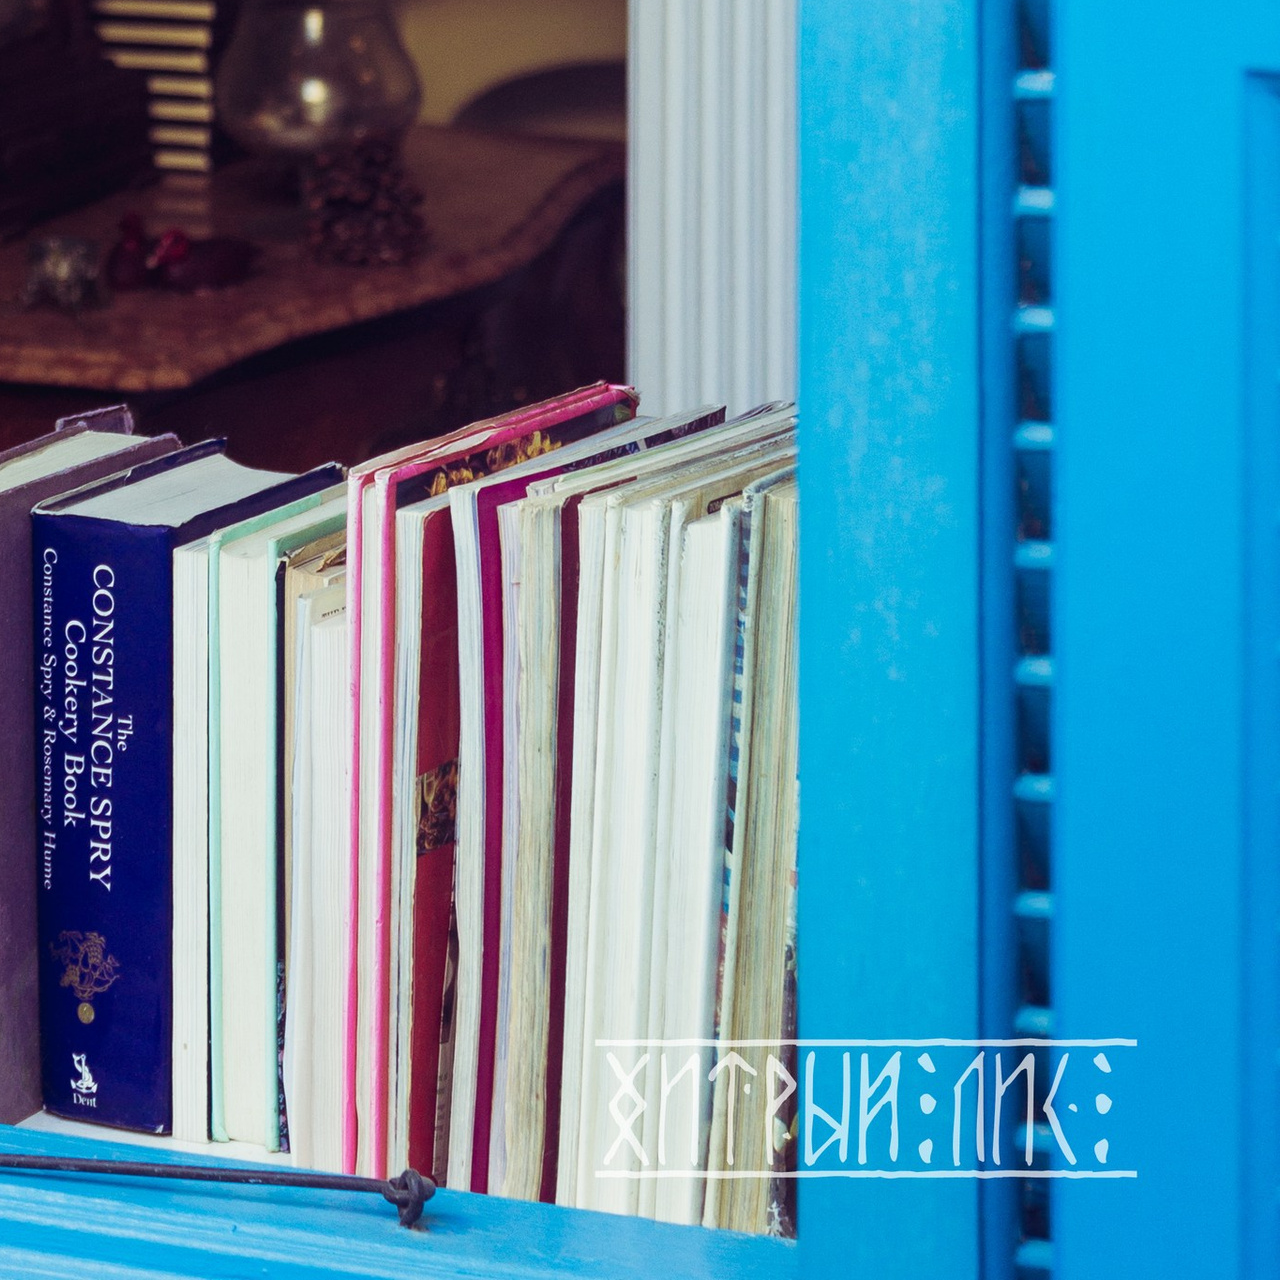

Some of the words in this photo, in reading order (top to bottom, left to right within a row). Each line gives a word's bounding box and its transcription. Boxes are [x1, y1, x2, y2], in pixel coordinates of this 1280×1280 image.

[43, 547, 58, 647] Constance
[40, 653, 58, 700] Spry
[58, 619, 87, 744] Cookery
[90, 564, 115, 787] CONSTANCE
[43, 705, 57, 723] &
[117, 715, 133, 752] The
[40, 729, 57, 825] Rosemary
[64, 751, 86, 827] Book
[43, 830, 57, 890] Hume
[89, 798, 113, 891] SPRY
[73, 1092, 97, 1108] Dent
